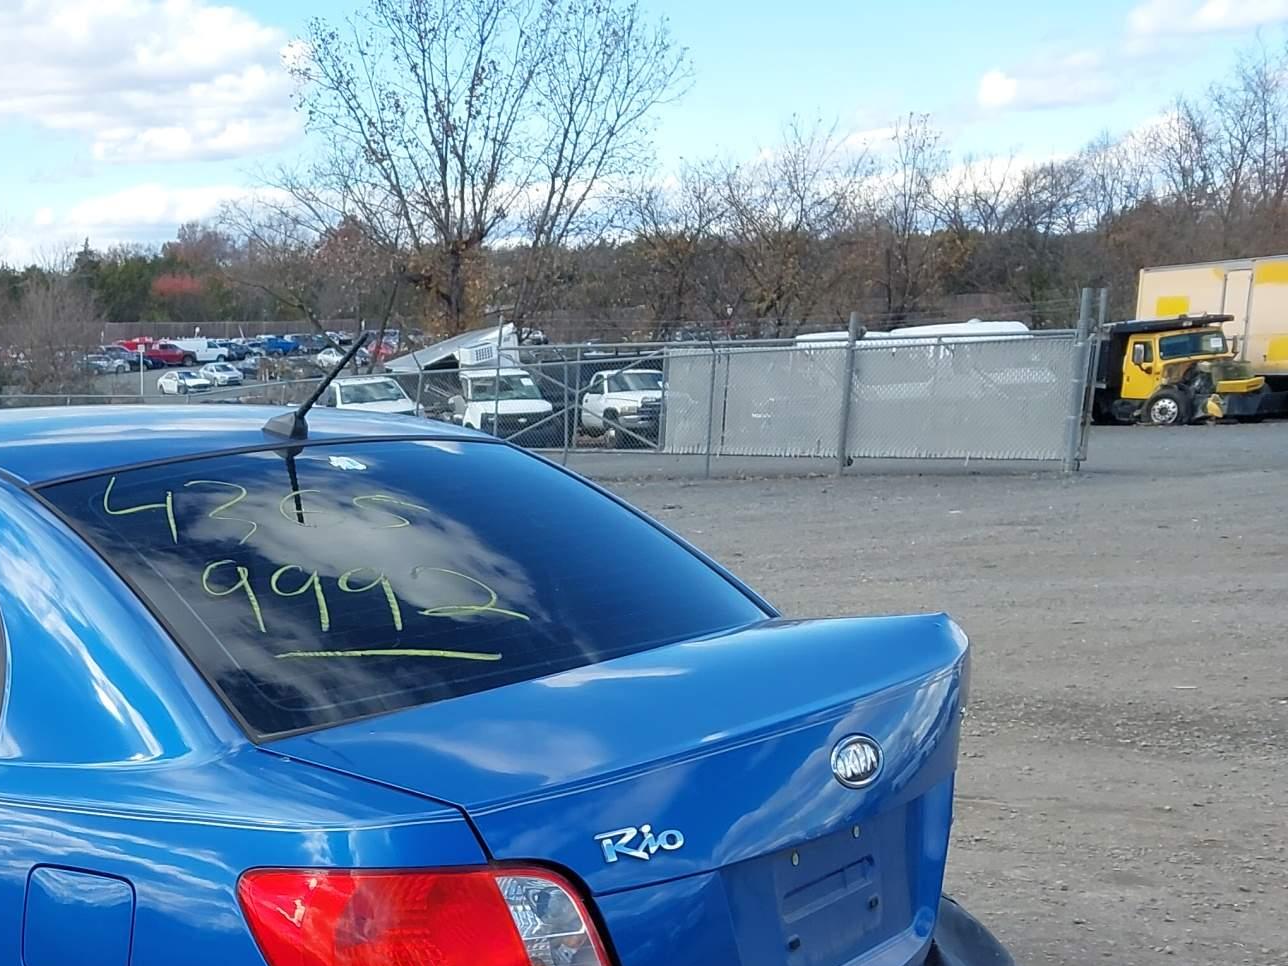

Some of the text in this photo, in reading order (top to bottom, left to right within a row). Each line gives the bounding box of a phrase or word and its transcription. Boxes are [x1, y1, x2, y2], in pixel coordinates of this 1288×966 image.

[201, 557, 531, 634] 9992
[836, 742, 878, 778] KIA
[593, 824, 685, 863] Rio
